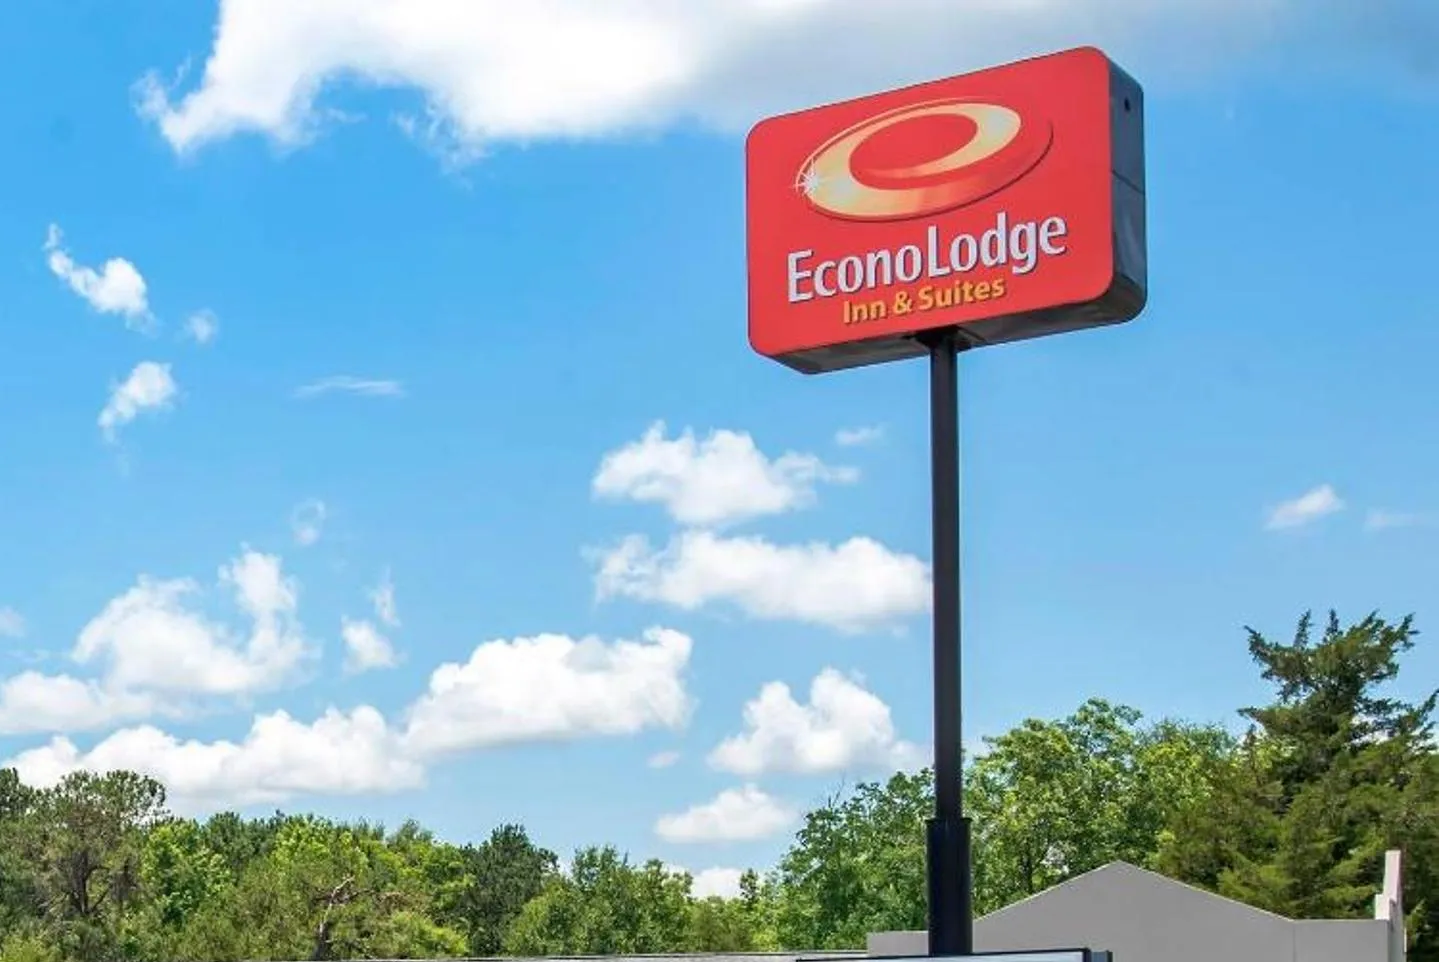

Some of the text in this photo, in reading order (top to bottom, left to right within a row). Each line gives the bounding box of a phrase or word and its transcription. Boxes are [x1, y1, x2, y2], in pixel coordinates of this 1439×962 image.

[843, 276, 1007, 324] Inn & Suites
